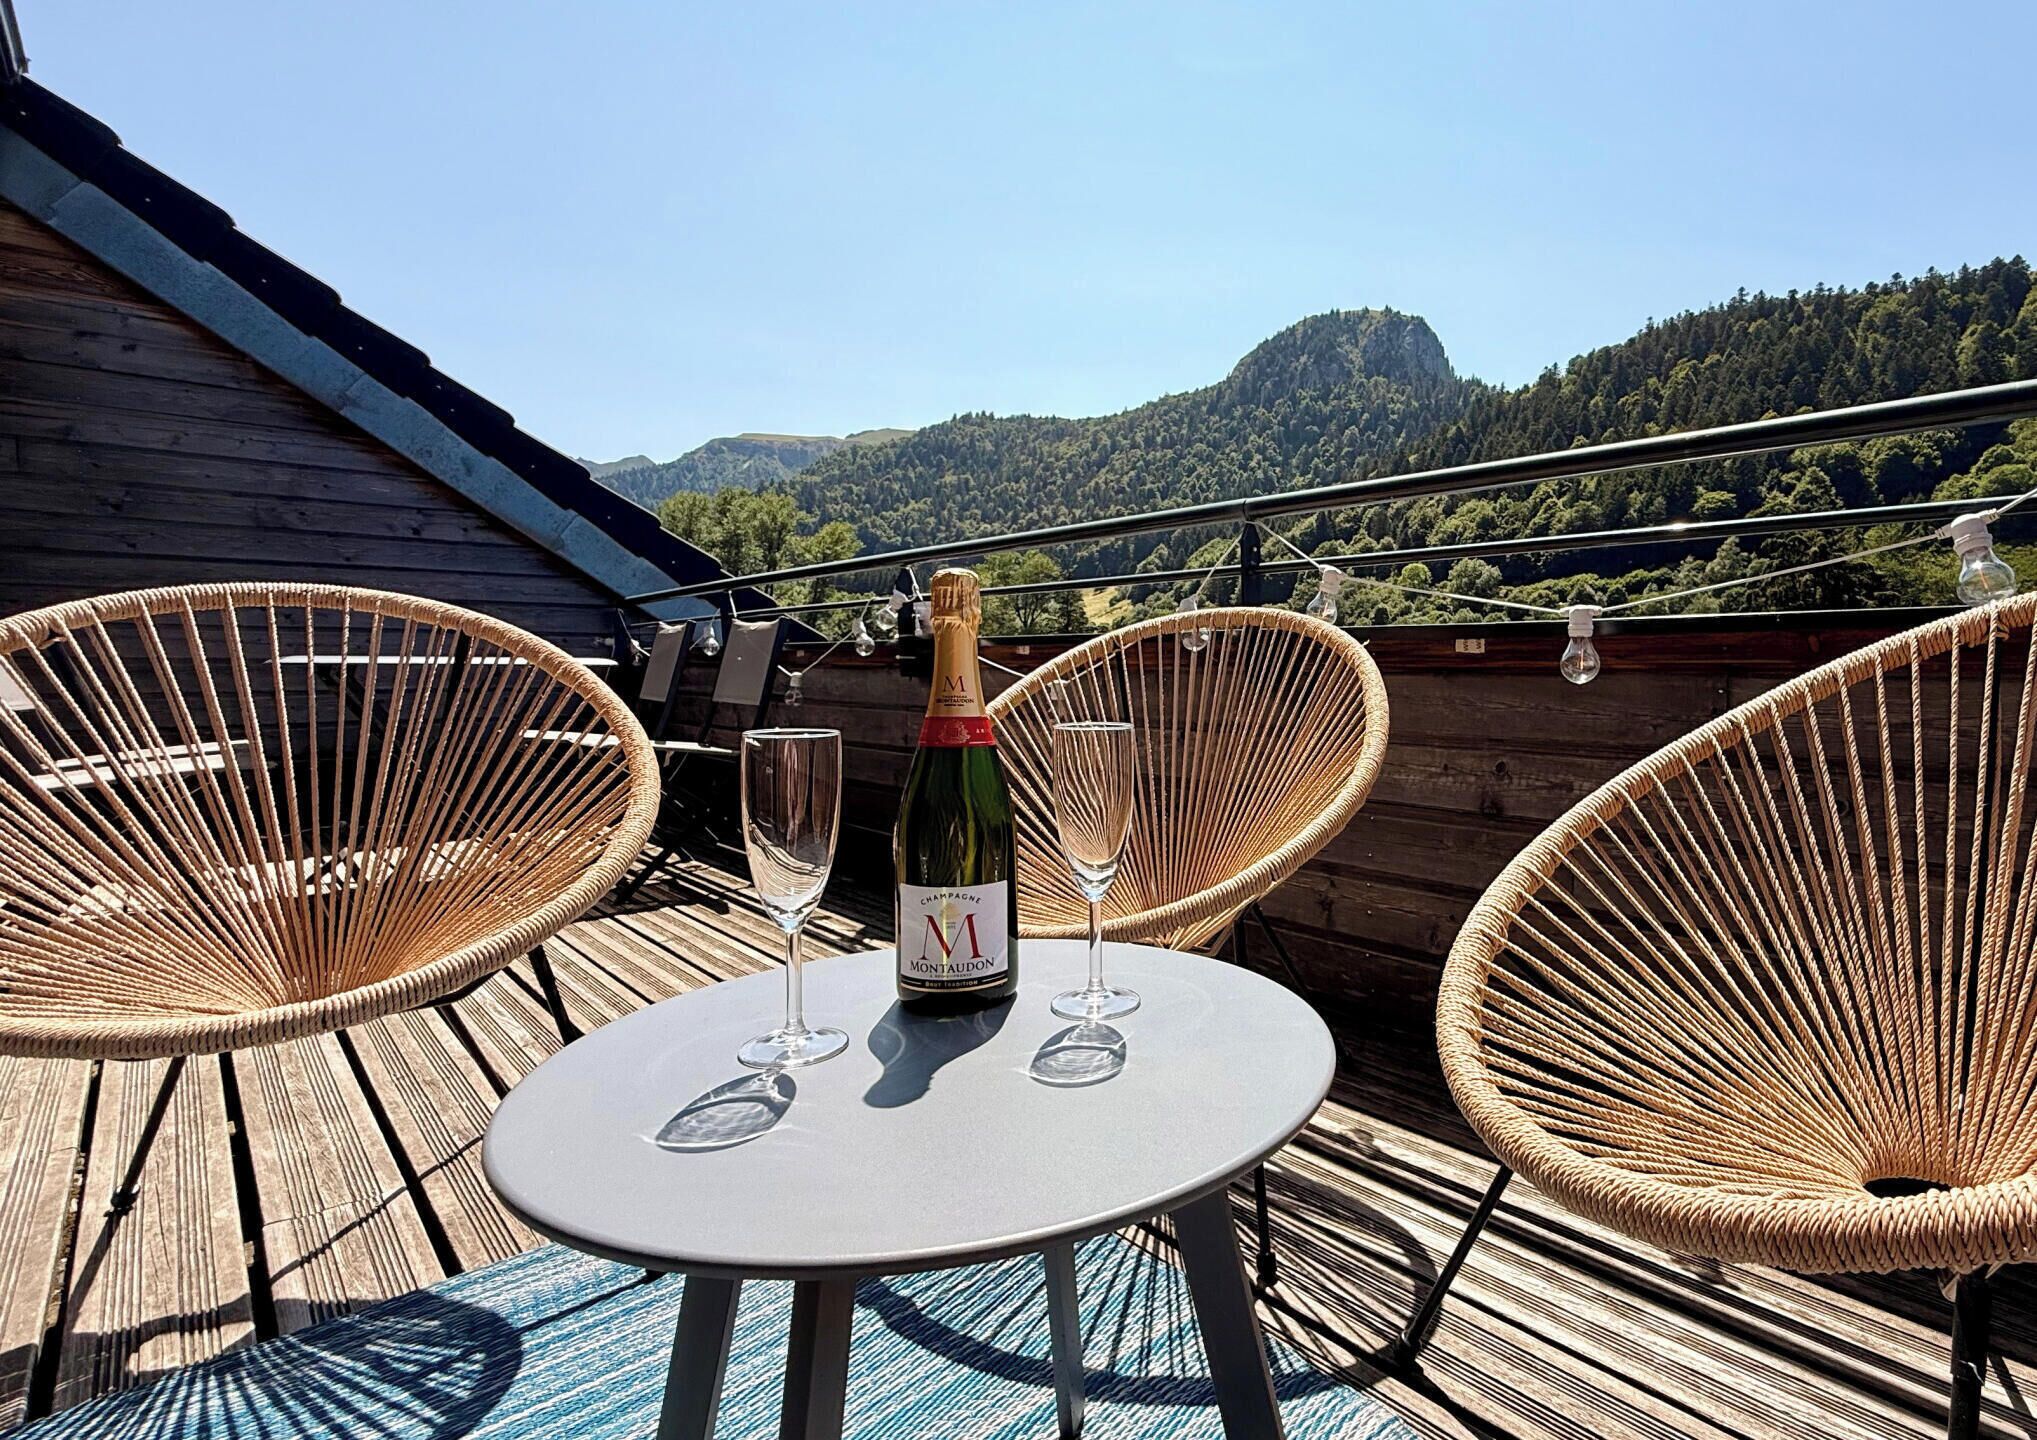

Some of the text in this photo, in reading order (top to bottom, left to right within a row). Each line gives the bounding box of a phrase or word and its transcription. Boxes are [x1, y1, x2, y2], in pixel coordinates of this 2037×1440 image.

[943, 675, 966, 692] M
[920, 892, 982, 906] CHAMPAGNE
[918, 913, 984, 960] M
[910, 957, 995, 974] MONTAUDON
